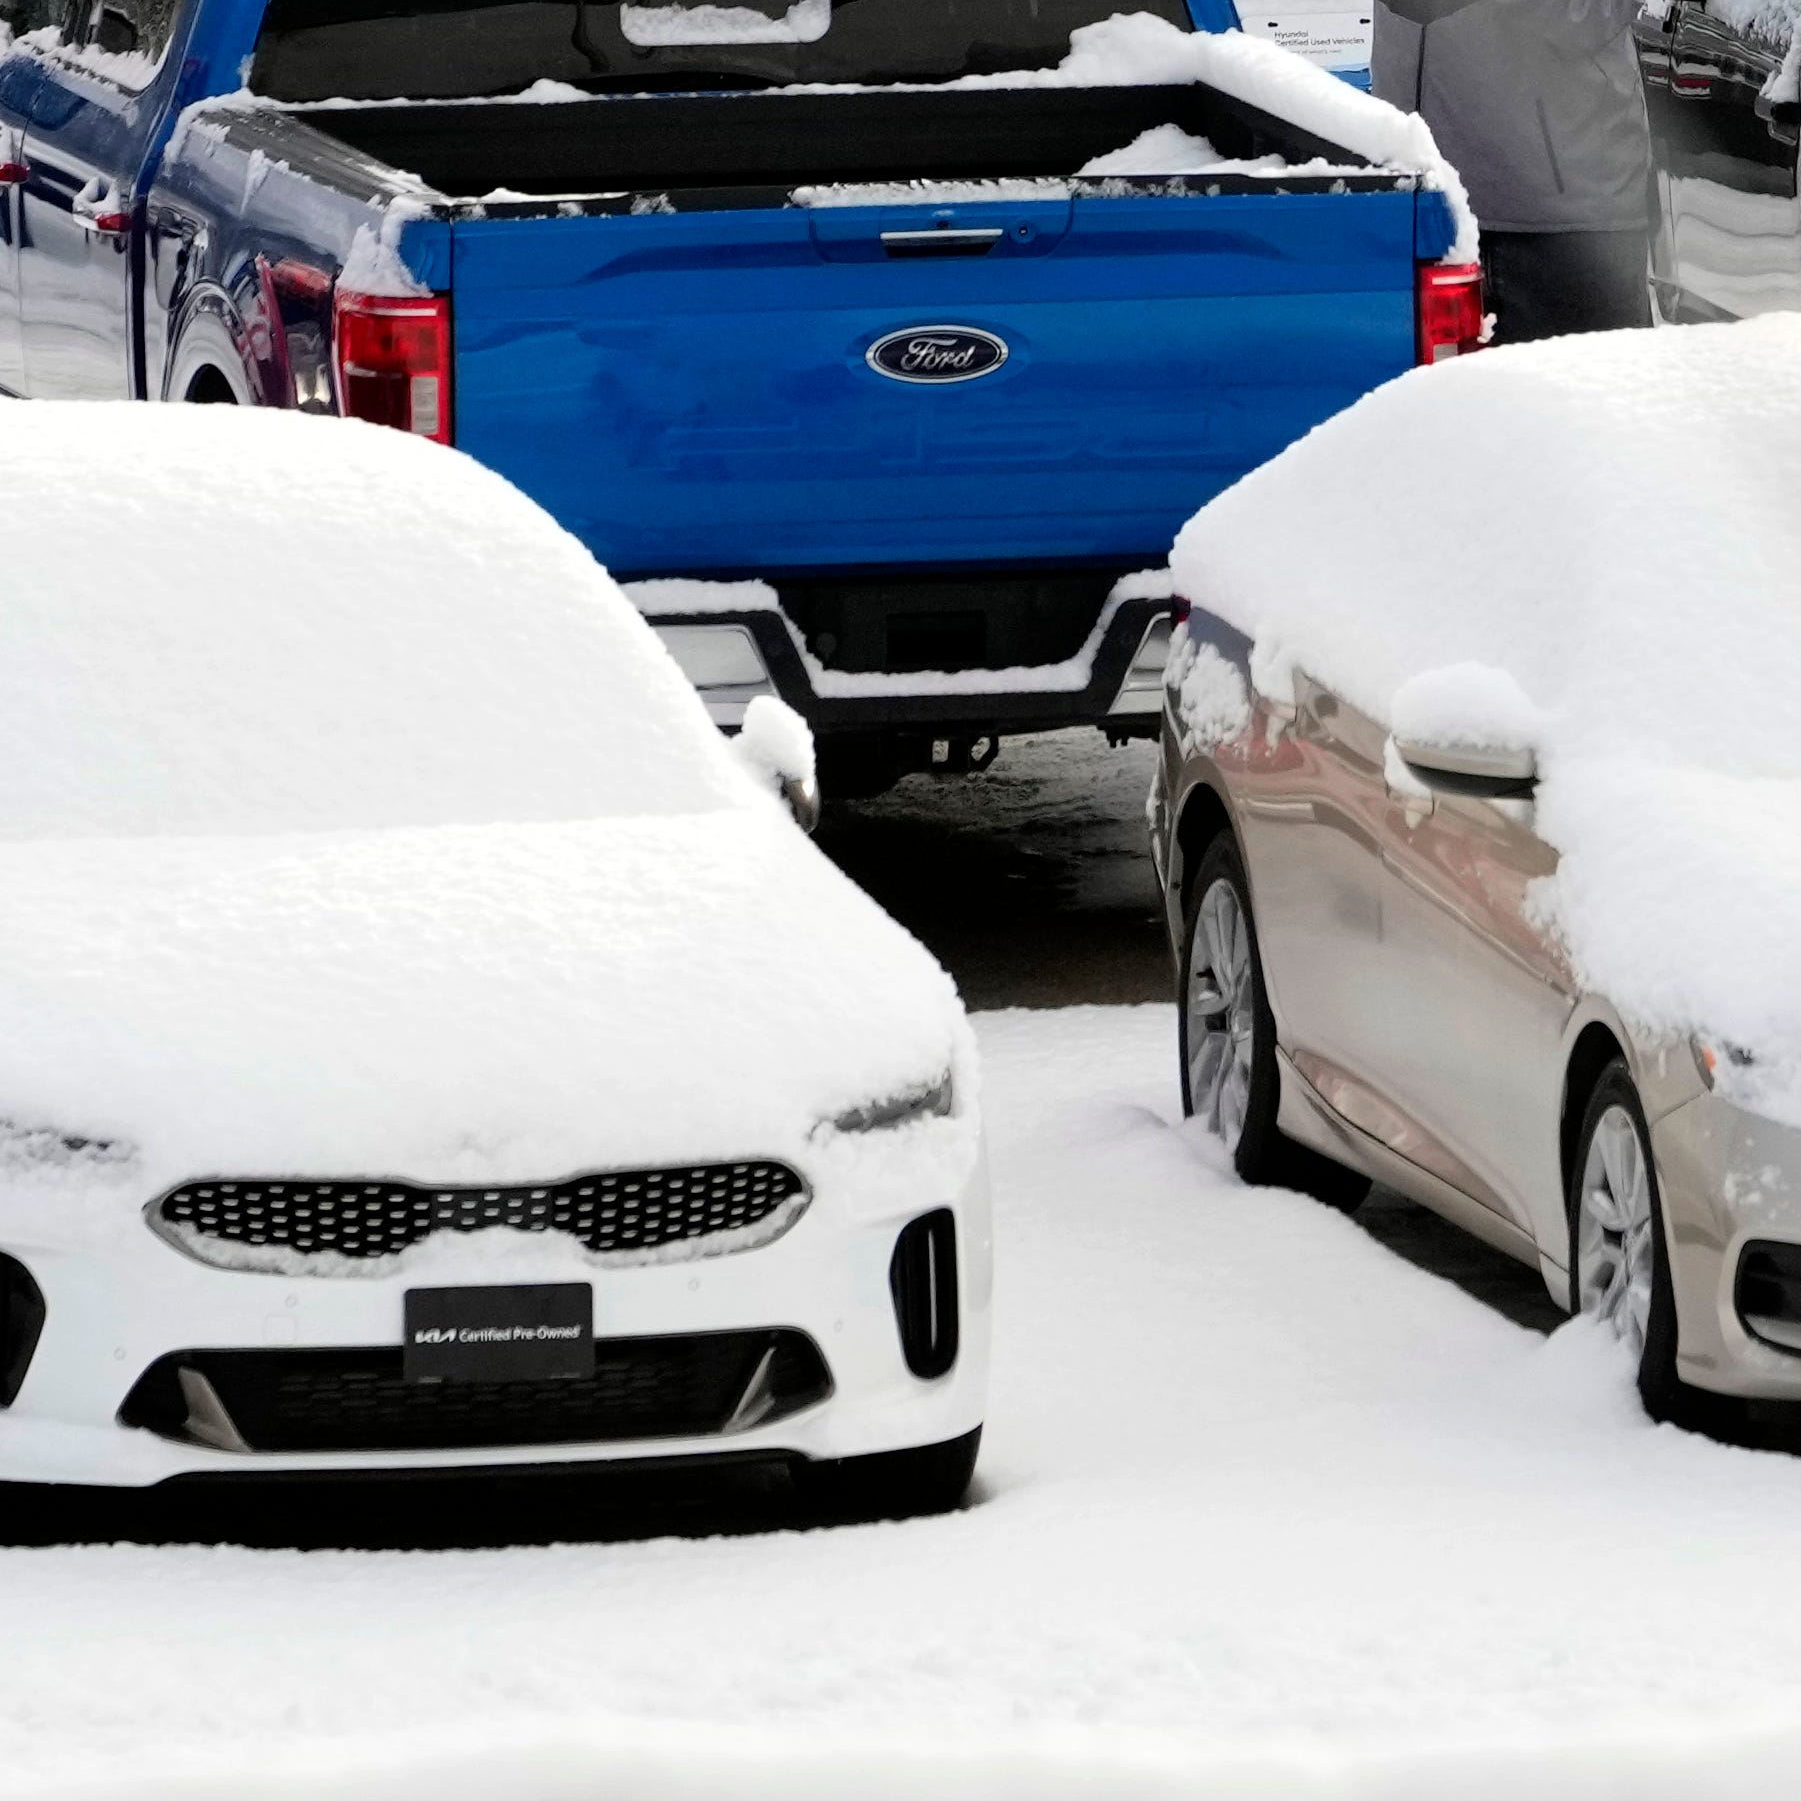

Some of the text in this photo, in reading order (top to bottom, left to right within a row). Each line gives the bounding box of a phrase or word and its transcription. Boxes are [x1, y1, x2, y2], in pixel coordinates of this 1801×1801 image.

[900, 336, 977, 372] Ford
[458, 1327, 513, 1343] Certified
[512, 1324, 582, 1342] Pre-Owned
